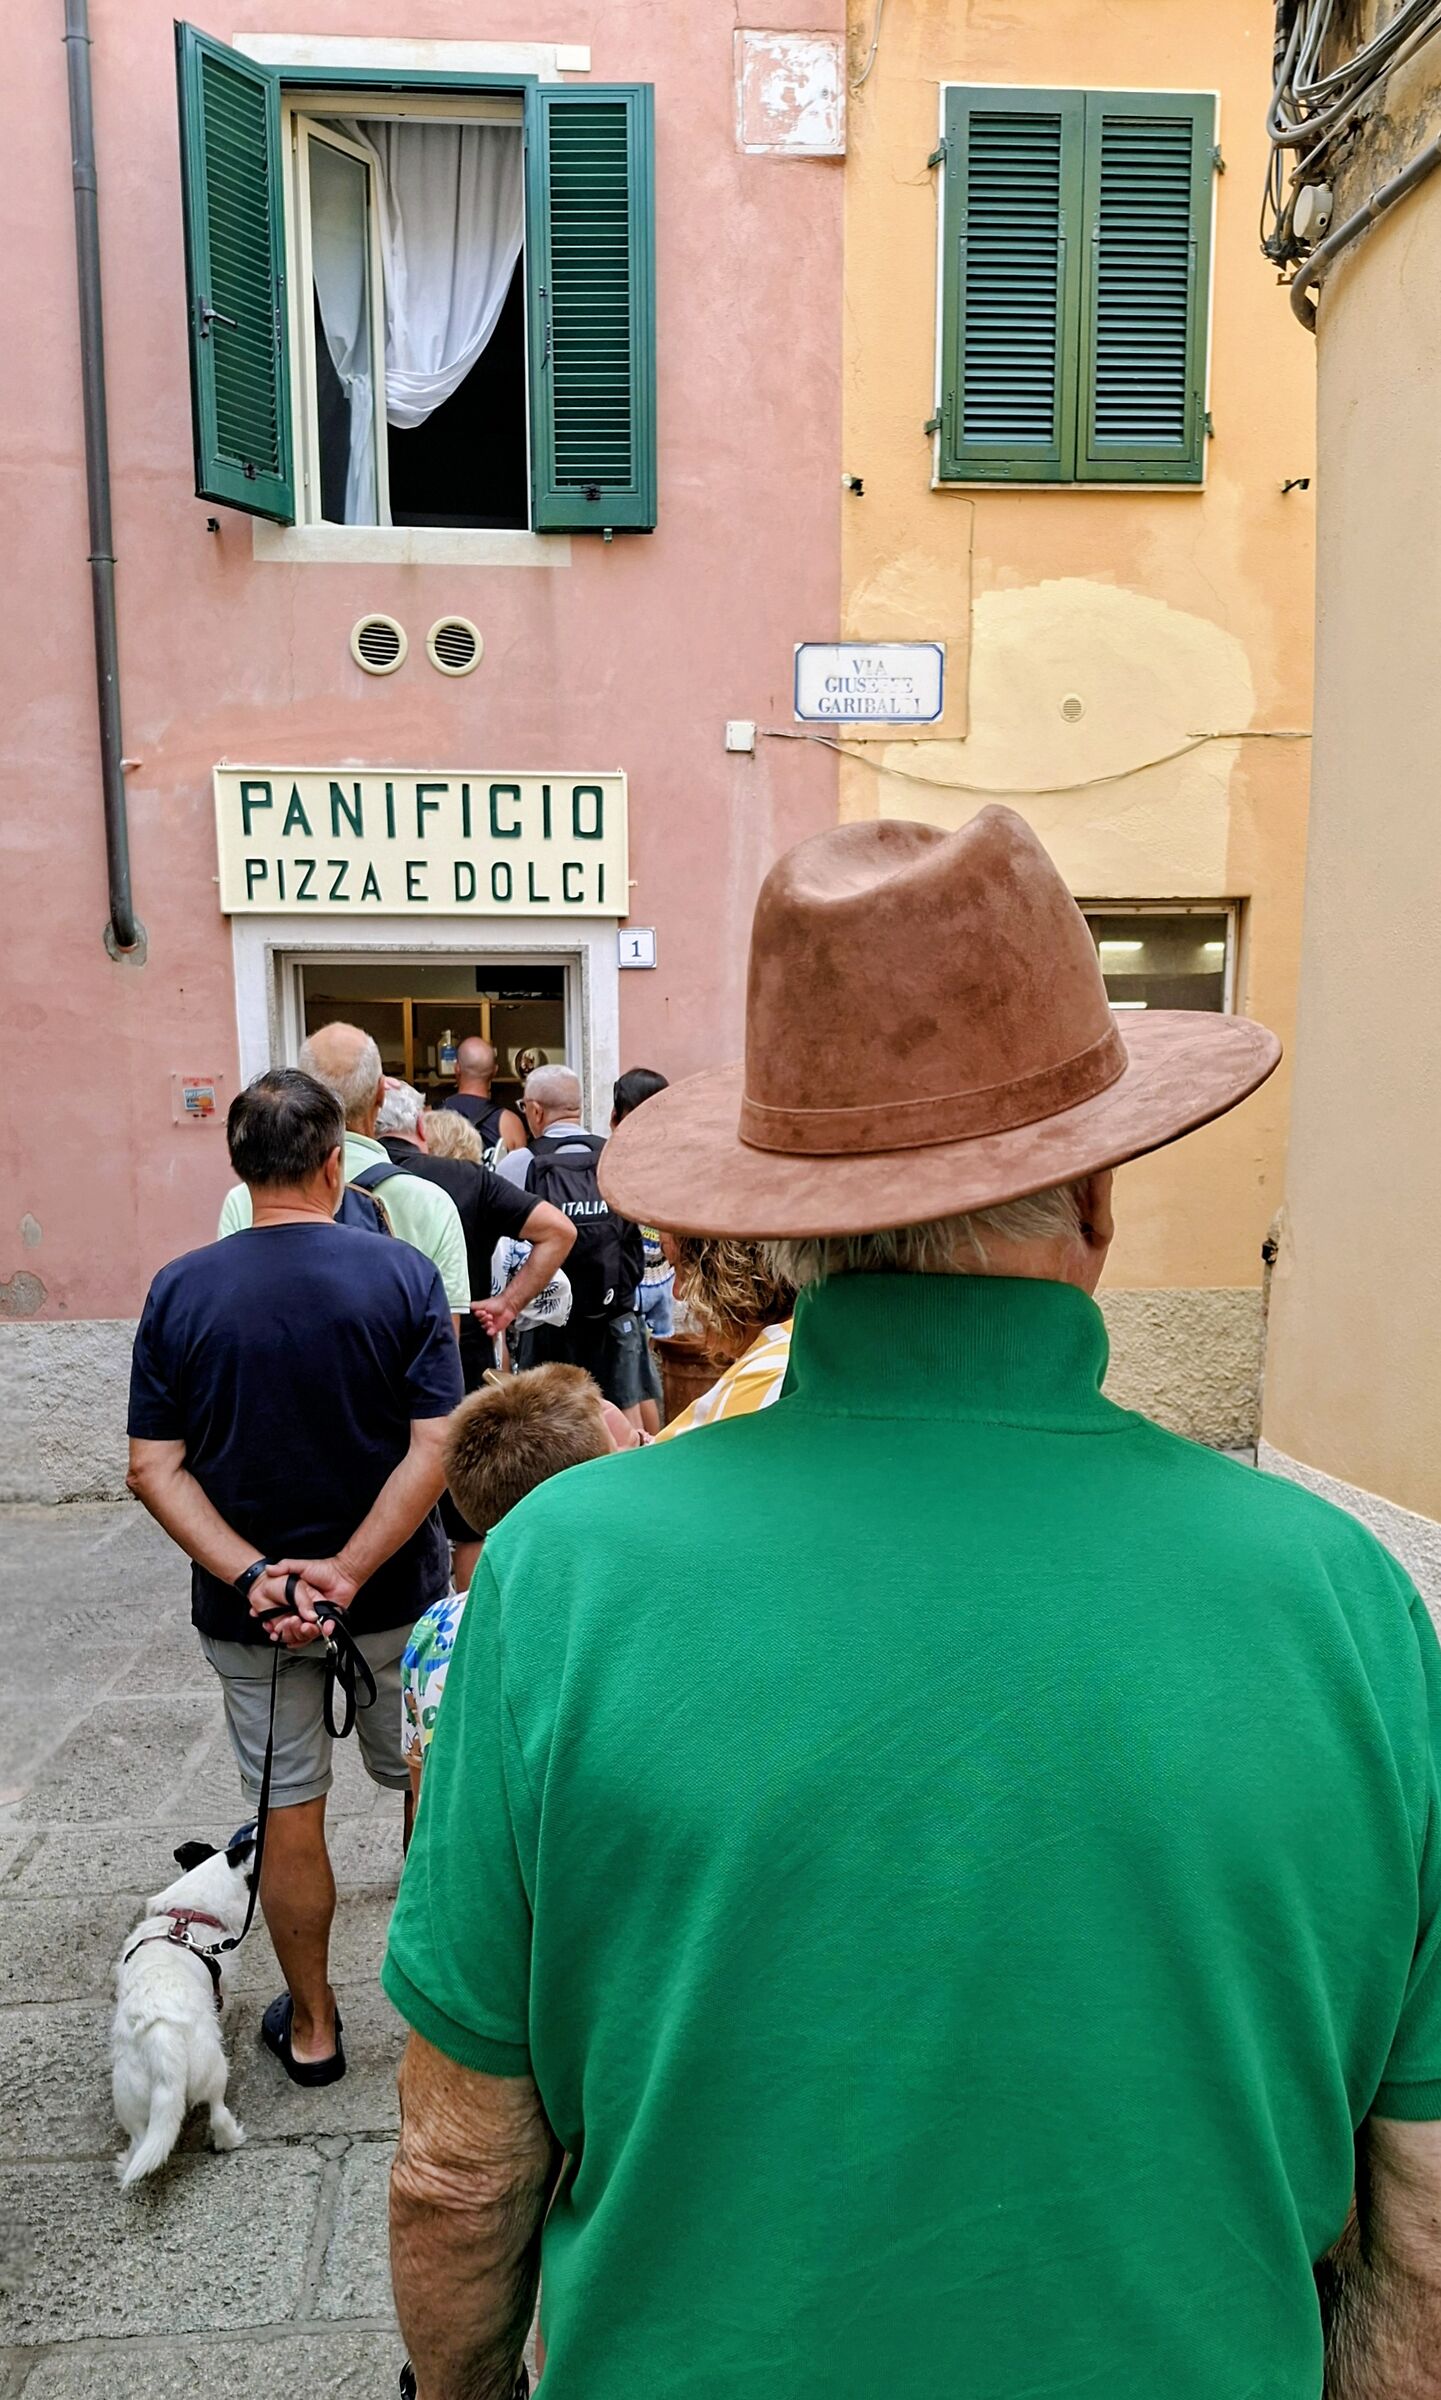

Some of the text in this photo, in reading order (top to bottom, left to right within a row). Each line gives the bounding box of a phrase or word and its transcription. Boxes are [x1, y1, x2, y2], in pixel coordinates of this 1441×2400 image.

[852, 659, 888, 675] VIA
[818, 698, 921, 714] GARIBALI
[239, 780, 604, 840] PANIFICIO
[244, 858, 606, 904] PIZZA E DOLCI
[631, 939, 642, 958] 1
[561, 1200, 609, 1216] ITALIA
